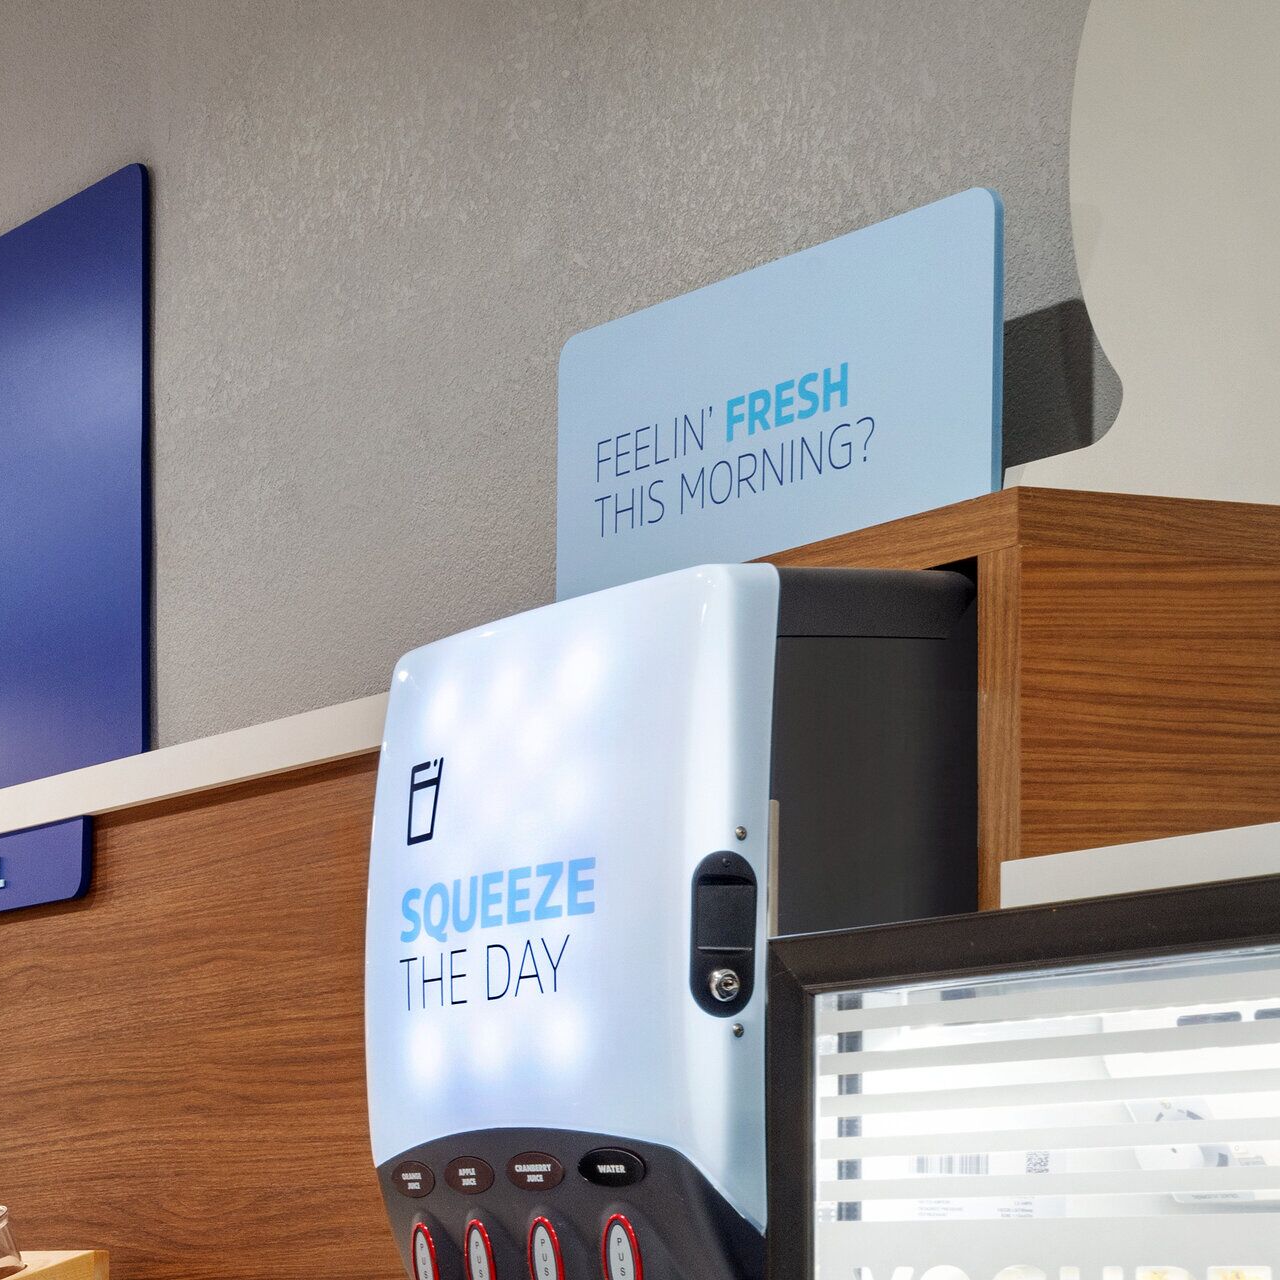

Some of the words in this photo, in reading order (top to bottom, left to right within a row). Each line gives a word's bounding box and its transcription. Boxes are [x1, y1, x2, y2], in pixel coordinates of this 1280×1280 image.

[726, 362, 849, 443] FRESH
[594, 480, 665, 538] THIS
[680, 416, 876, 516] MORNING?
[400, 857, 596, 943] SQUEEZE
[399, 948, 468, 1011] THE
[486, 934, 570, 1001] DAY
[458, 1168, 476, 1177] APPLE
[514, 1164, 552, 1173] CRANBERRY
[597, 1164, 626, 1174] WATER
[462, 1178, 477, 1186] JUICE
[526, 1174, 544, 1183] JUICE
[407, 1182, 421, 1190] JUICE
